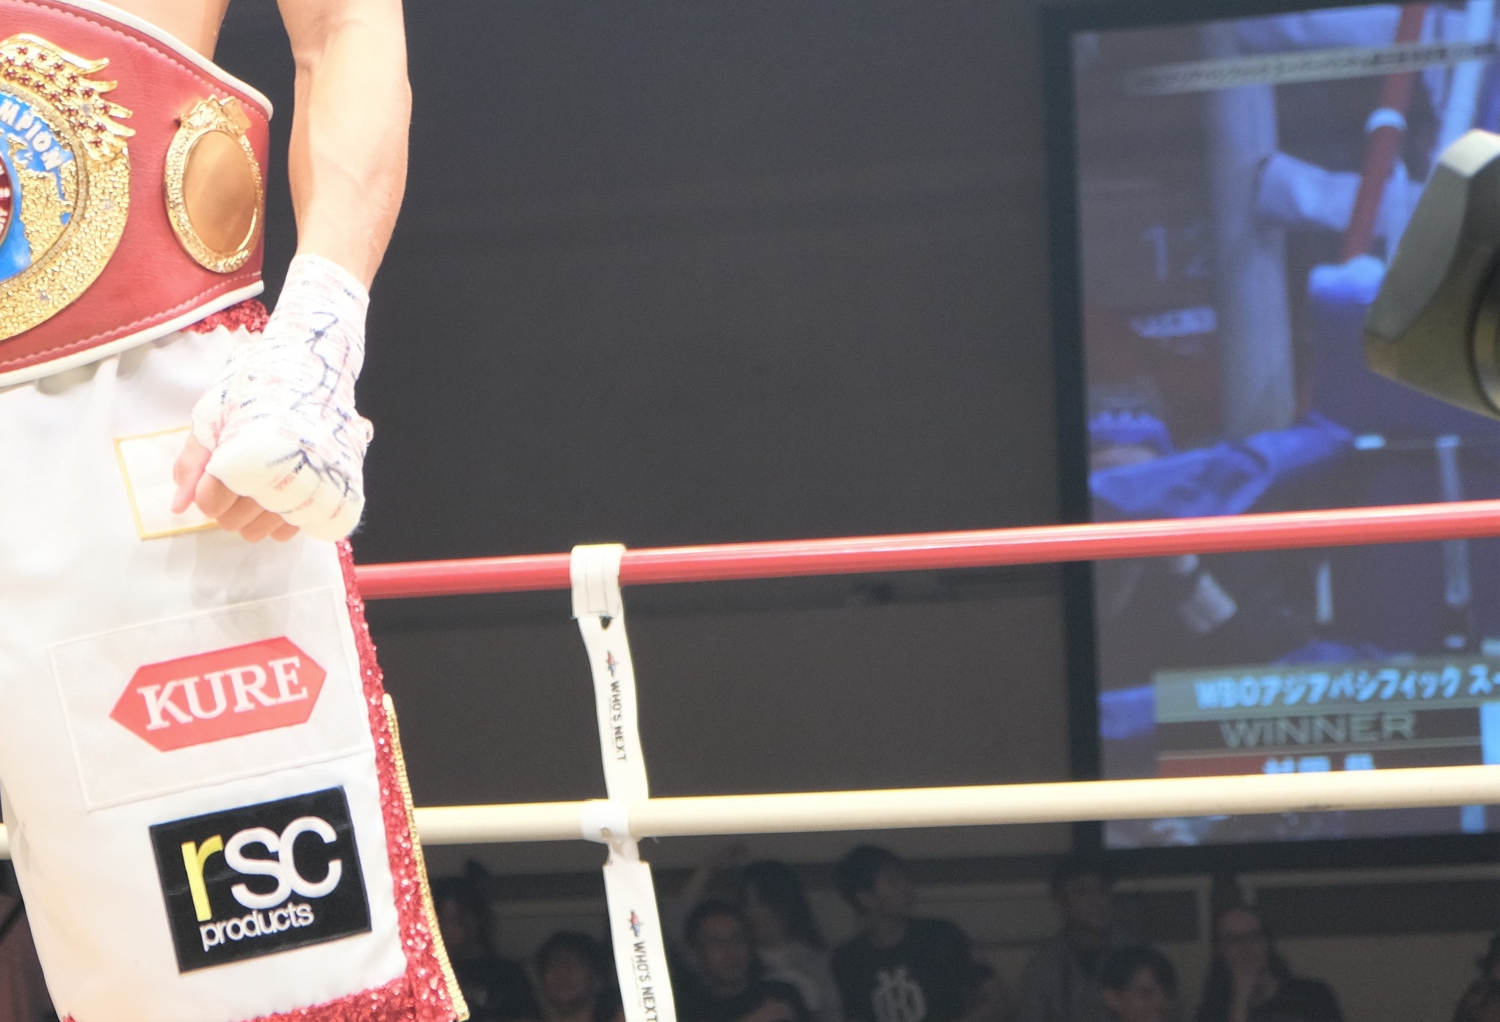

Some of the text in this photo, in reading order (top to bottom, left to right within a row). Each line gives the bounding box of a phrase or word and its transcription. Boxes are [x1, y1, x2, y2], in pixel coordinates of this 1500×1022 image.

[137, 656, 308, 731] KURE
[610, 679, 623, 723] WHO'S
[613, 724, 627, 762] NEXT
[1219, 709, 1418, 749] WINNER
[199, 903, 315, 952] products
[632, 940, 652, 983] WHO'S
[641, 985, 659, 1022] NEXT
